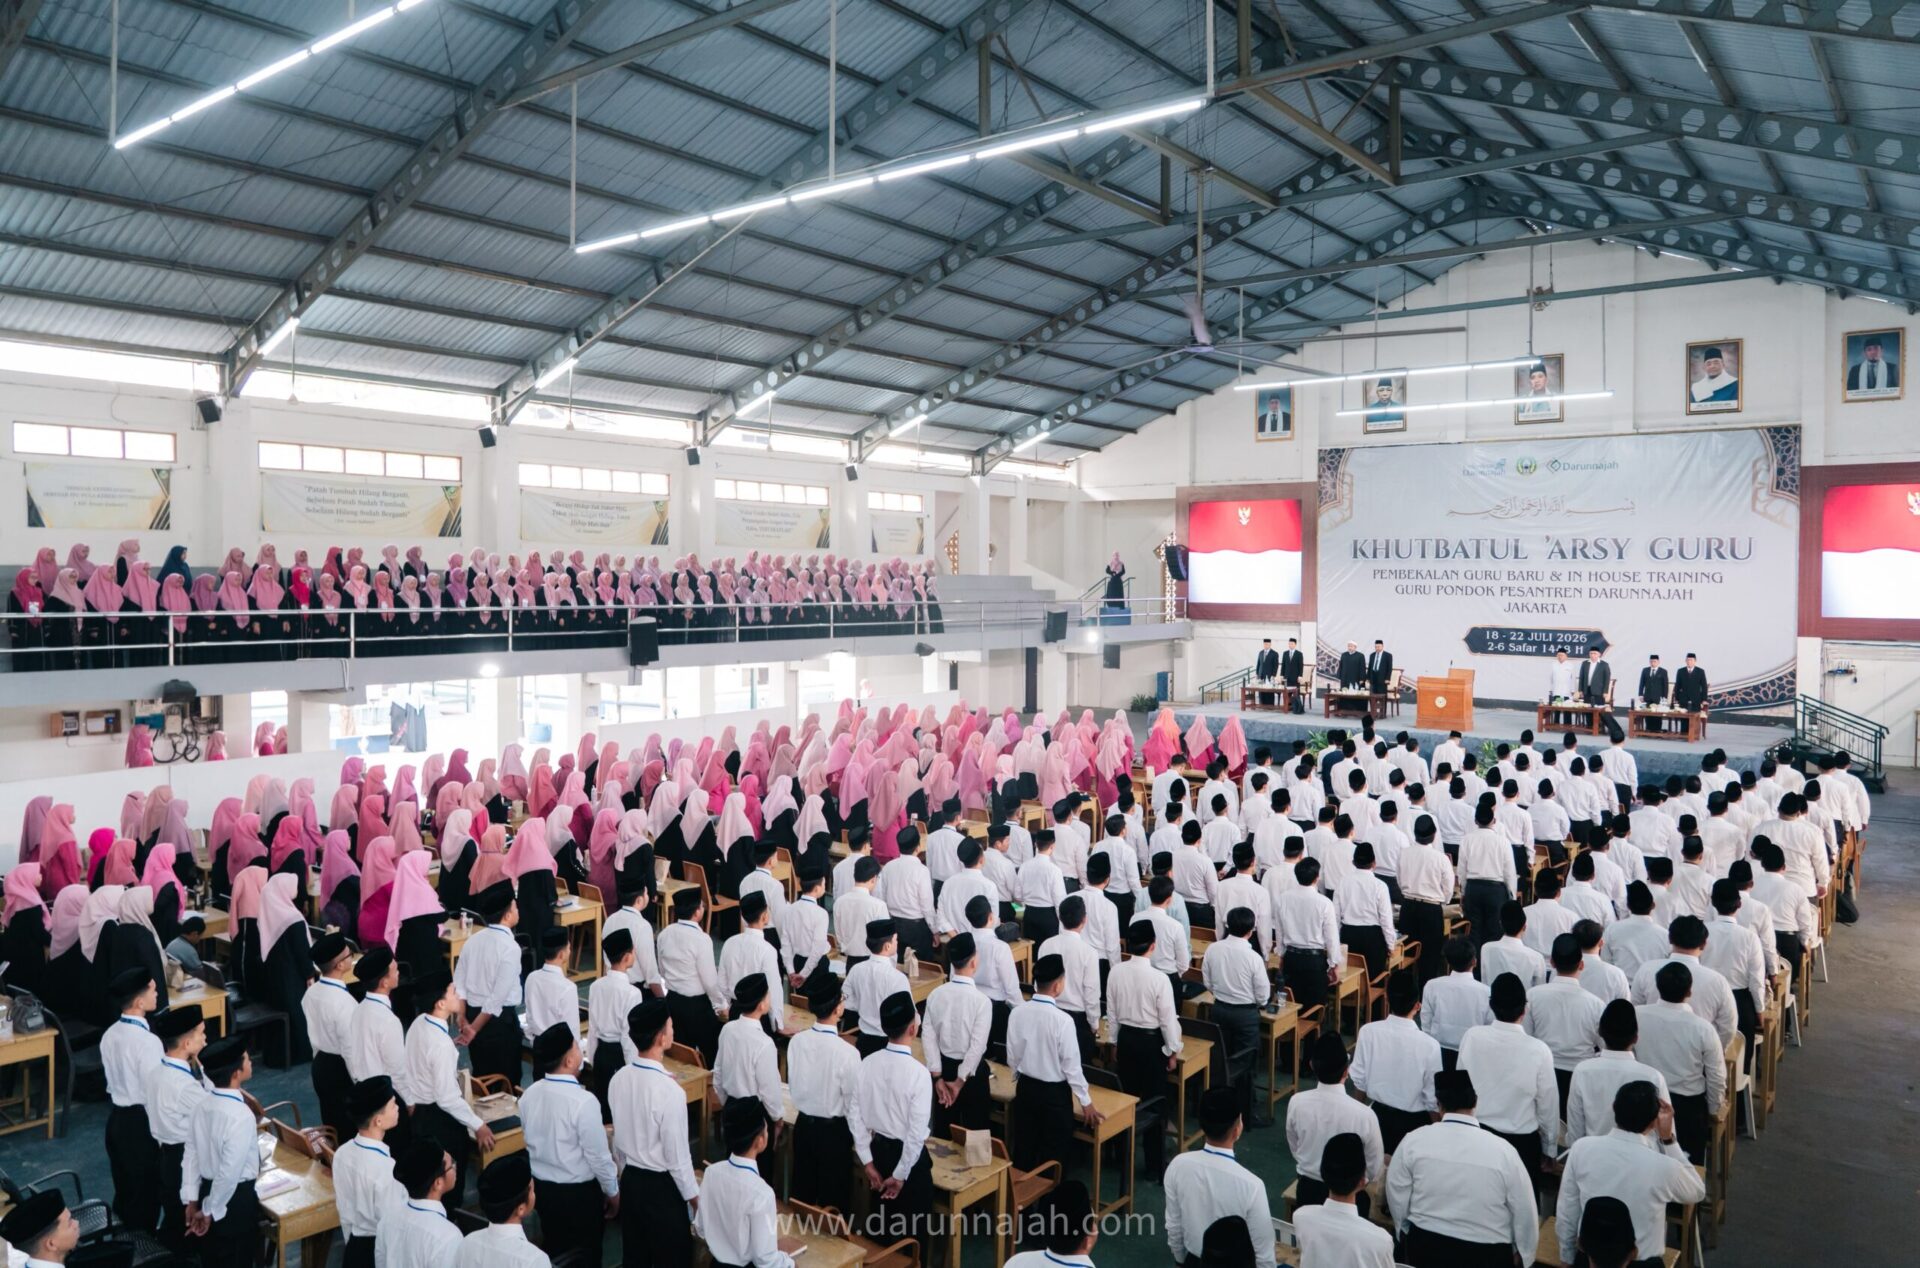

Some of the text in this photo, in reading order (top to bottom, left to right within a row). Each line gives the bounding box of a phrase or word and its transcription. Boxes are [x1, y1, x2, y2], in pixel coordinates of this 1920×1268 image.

[1563, 461, 1619, 472] Darunnajah
[1351, 537, 1528, 560] KHUTBATUL
[1648, 536, 1754, 561] GURU
[1373, 569, 1723, 584] PEMBEKALAN GURU BARU & IN HOUSE TRAINING
[1395, 584, 1693, 600] GURU PONDOK PESANTREN DARUNNAJAH
[1504, 602, 1567, 614] JAKARTA
[1485, 630, 1499, 640] 18
[1510, 631, 1524, 641] 22
[1528, 632, 1553, 642] JULI
[1556, 633, 1588, 643] 2026
[1487, 641, 1505, 651] 2-6
[1509, 642, 1537, 653] Safar
[1575, 645, 1584, 655] H
